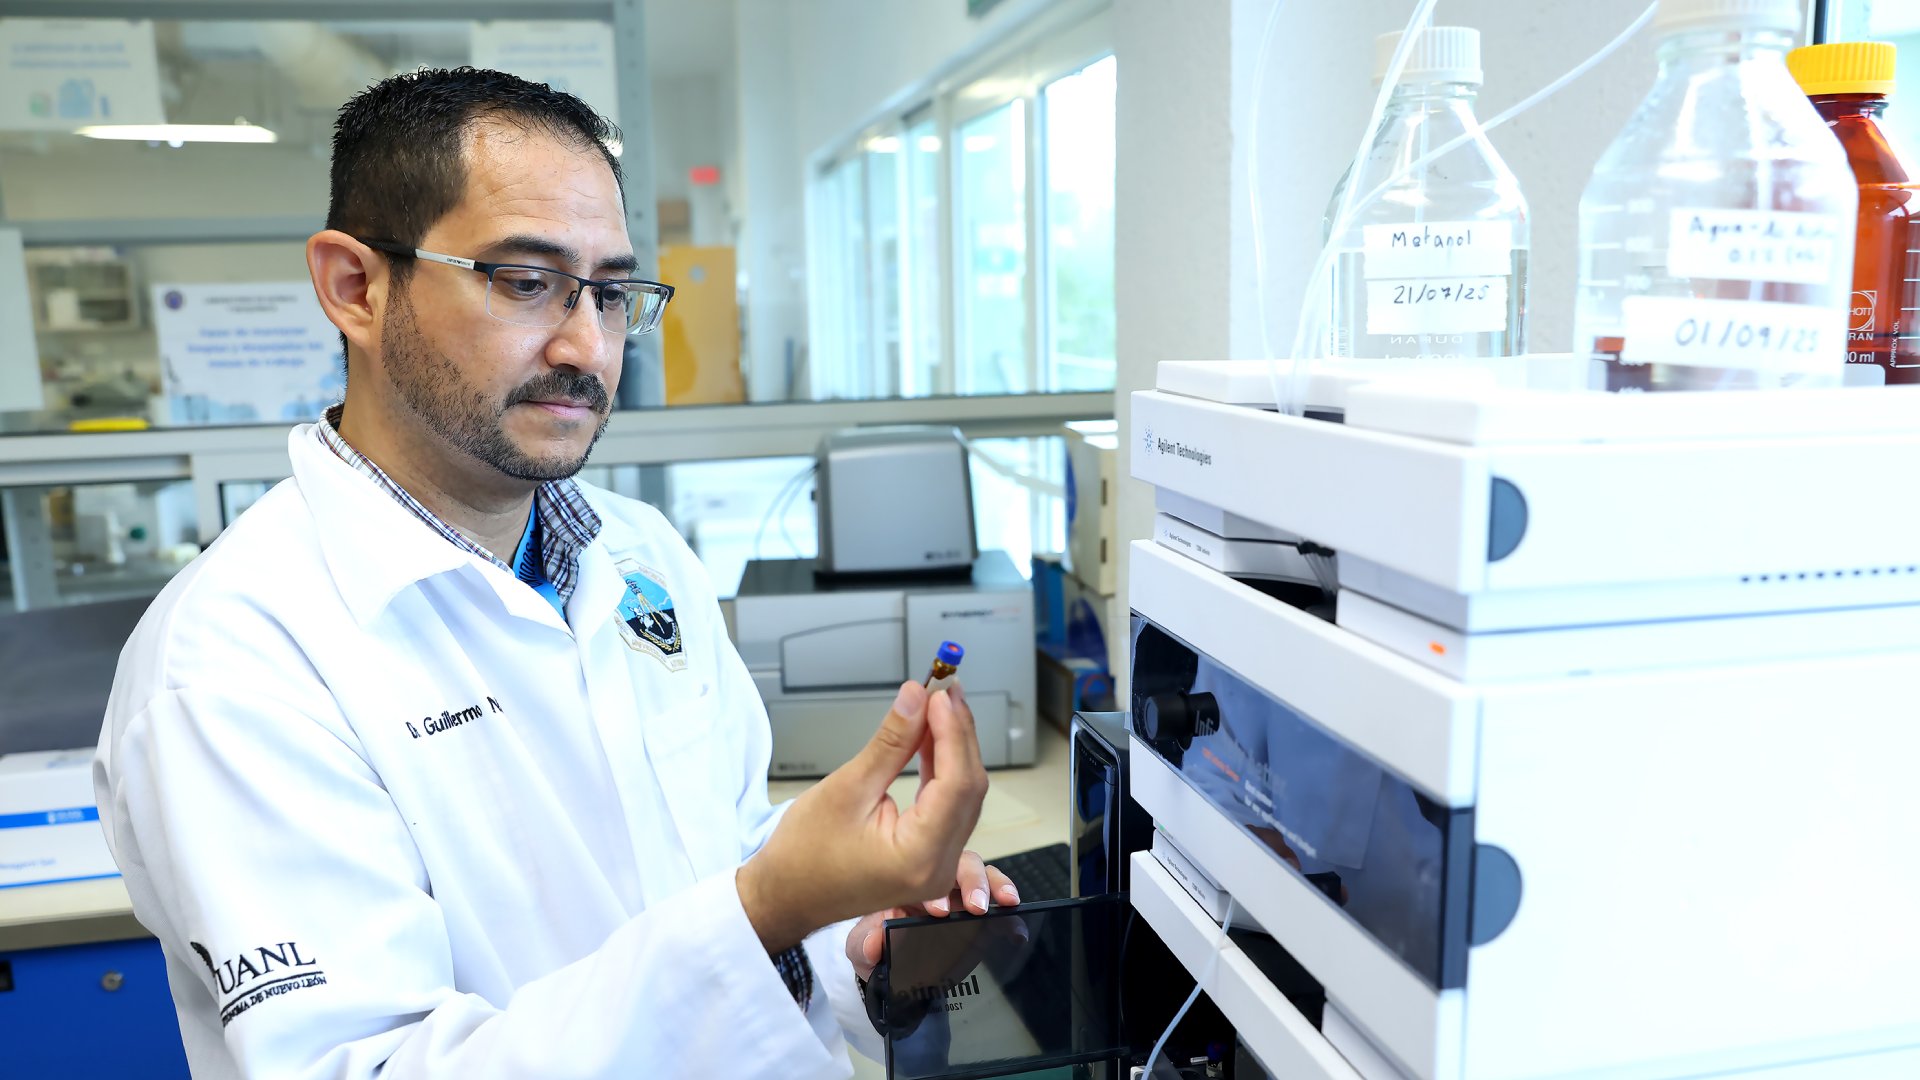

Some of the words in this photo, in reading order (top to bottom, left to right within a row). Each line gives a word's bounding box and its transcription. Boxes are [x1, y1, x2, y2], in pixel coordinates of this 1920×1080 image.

[1392, 225, 1471, 247] Metanol
[1393, 283, 1490, 304] 21/07/25
[1848, 307, 1872, 317] HOTT
[1848, 332, 1874, 341] RAN
[1859, 351, 1875, 363] ml
[1157, 437, 1176, 455] Agilent
[1176, 442, 1212, 466] Technologies
[423, 704, 484, 735] Guillermo
[215, 941, 317, 995] UANL
[250, 992, 265, 1006] DE
[265, 981, 300, 999] NUEVO
[301, 974, 327, 989] LEÓN
